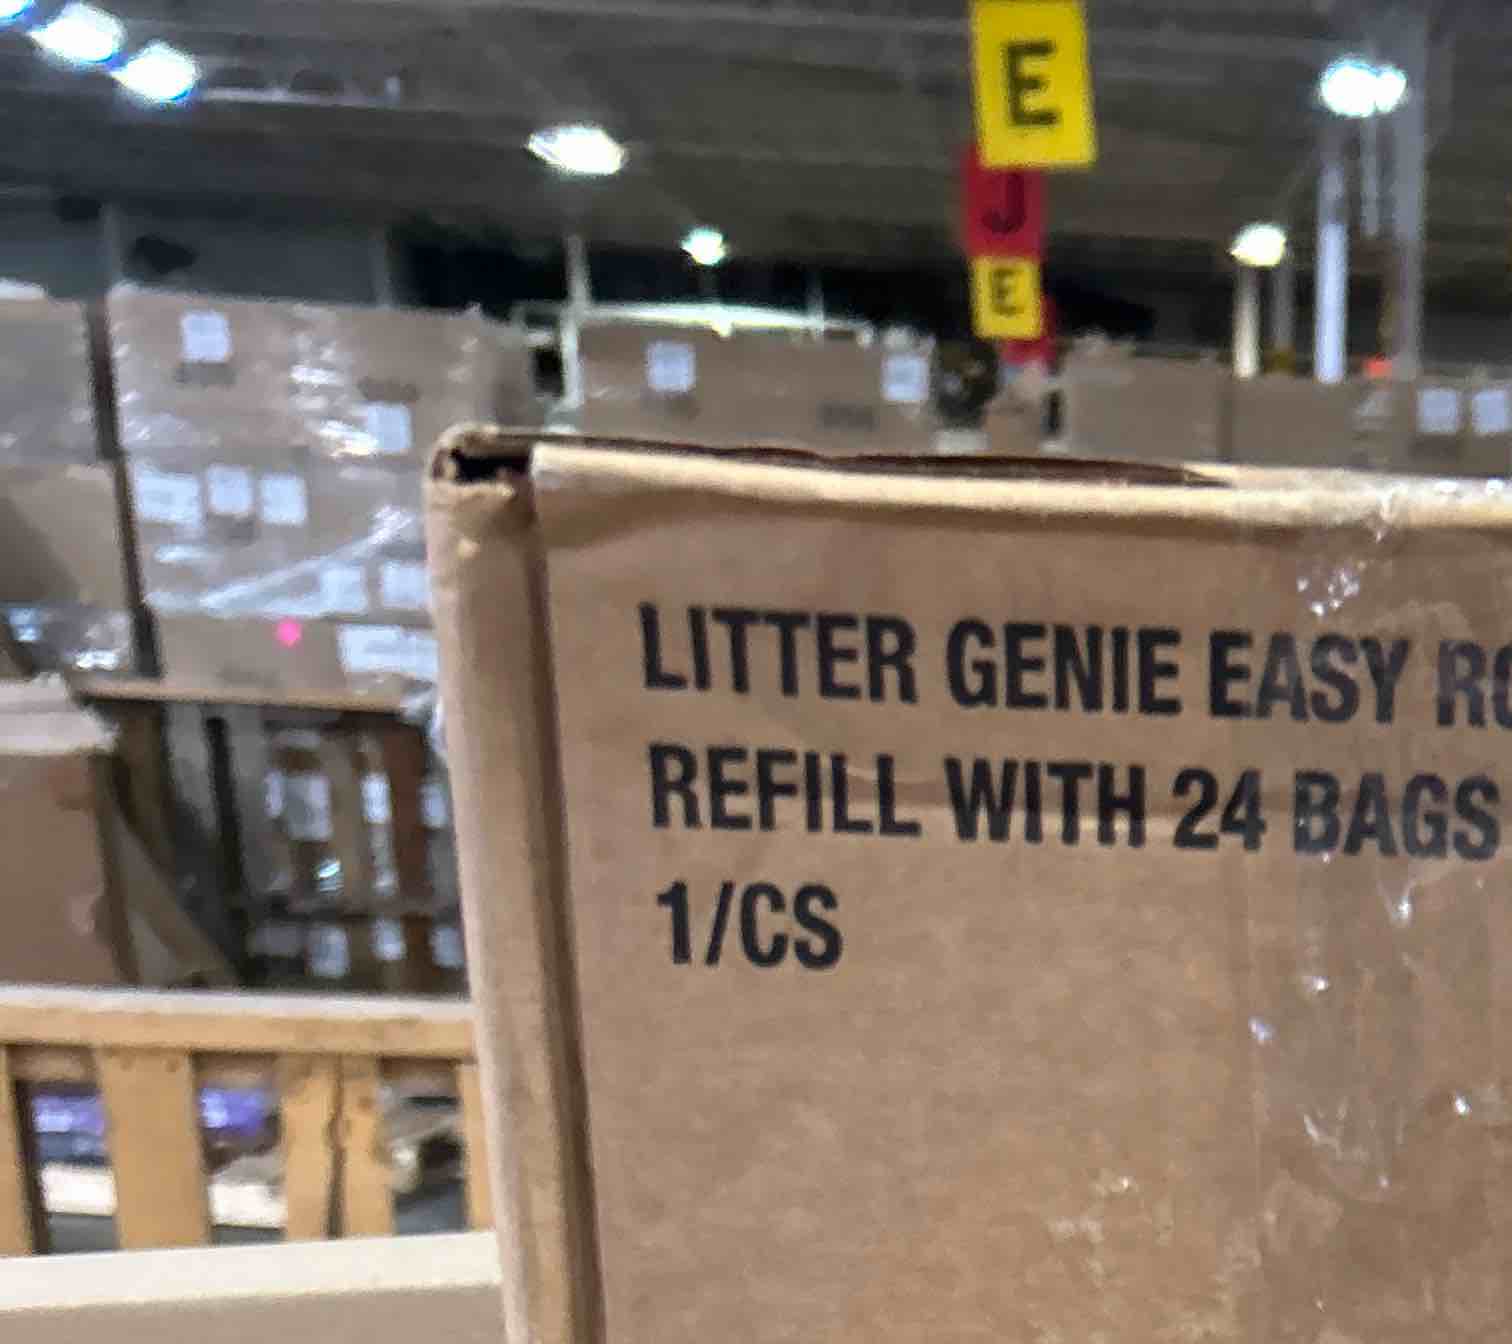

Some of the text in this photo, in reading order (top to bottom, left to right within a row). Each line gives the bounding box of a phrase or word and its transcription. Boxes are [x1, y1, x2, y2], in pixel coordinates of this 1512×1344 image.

[1005, 40, 1060, 125] E
[640, 602, 918, 704] LITTER
[945, 618, 1182, 715] GENIE
[1208, 630, 1411, 725] EASY
[649, 743, 1500, 861] REFILL WITH 24 BAGS
[657, 881, 843, 970] 1/CS
